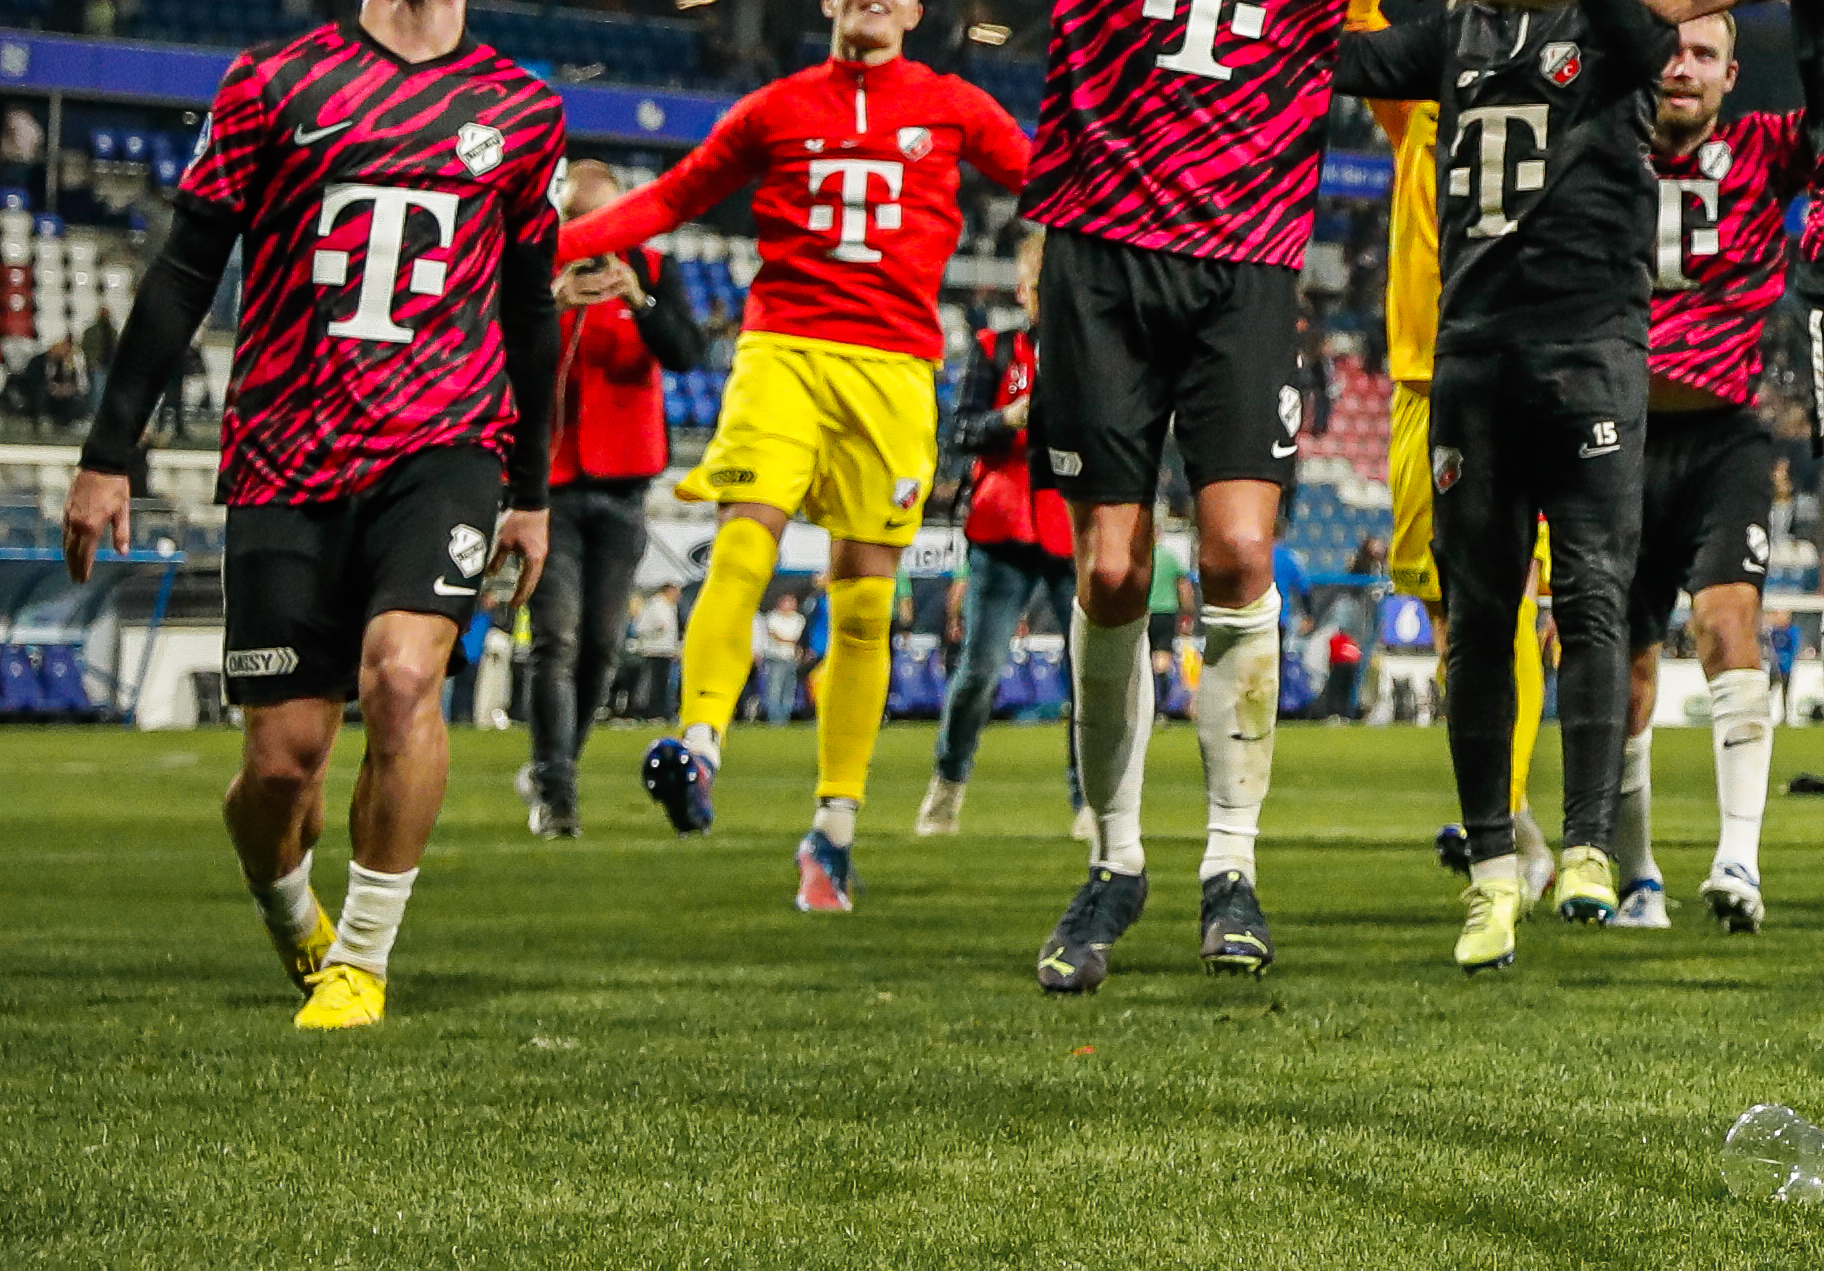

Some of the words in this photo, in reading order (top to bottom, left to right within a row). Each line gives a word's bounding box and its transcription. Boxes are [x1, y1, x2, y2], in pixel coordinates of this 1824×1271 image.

[809, 159, 903, 263] T
[1449, 104, 1550, 238] T
[312, 183, 459, 343] T
[1592, 421, 1618, 446] 15
